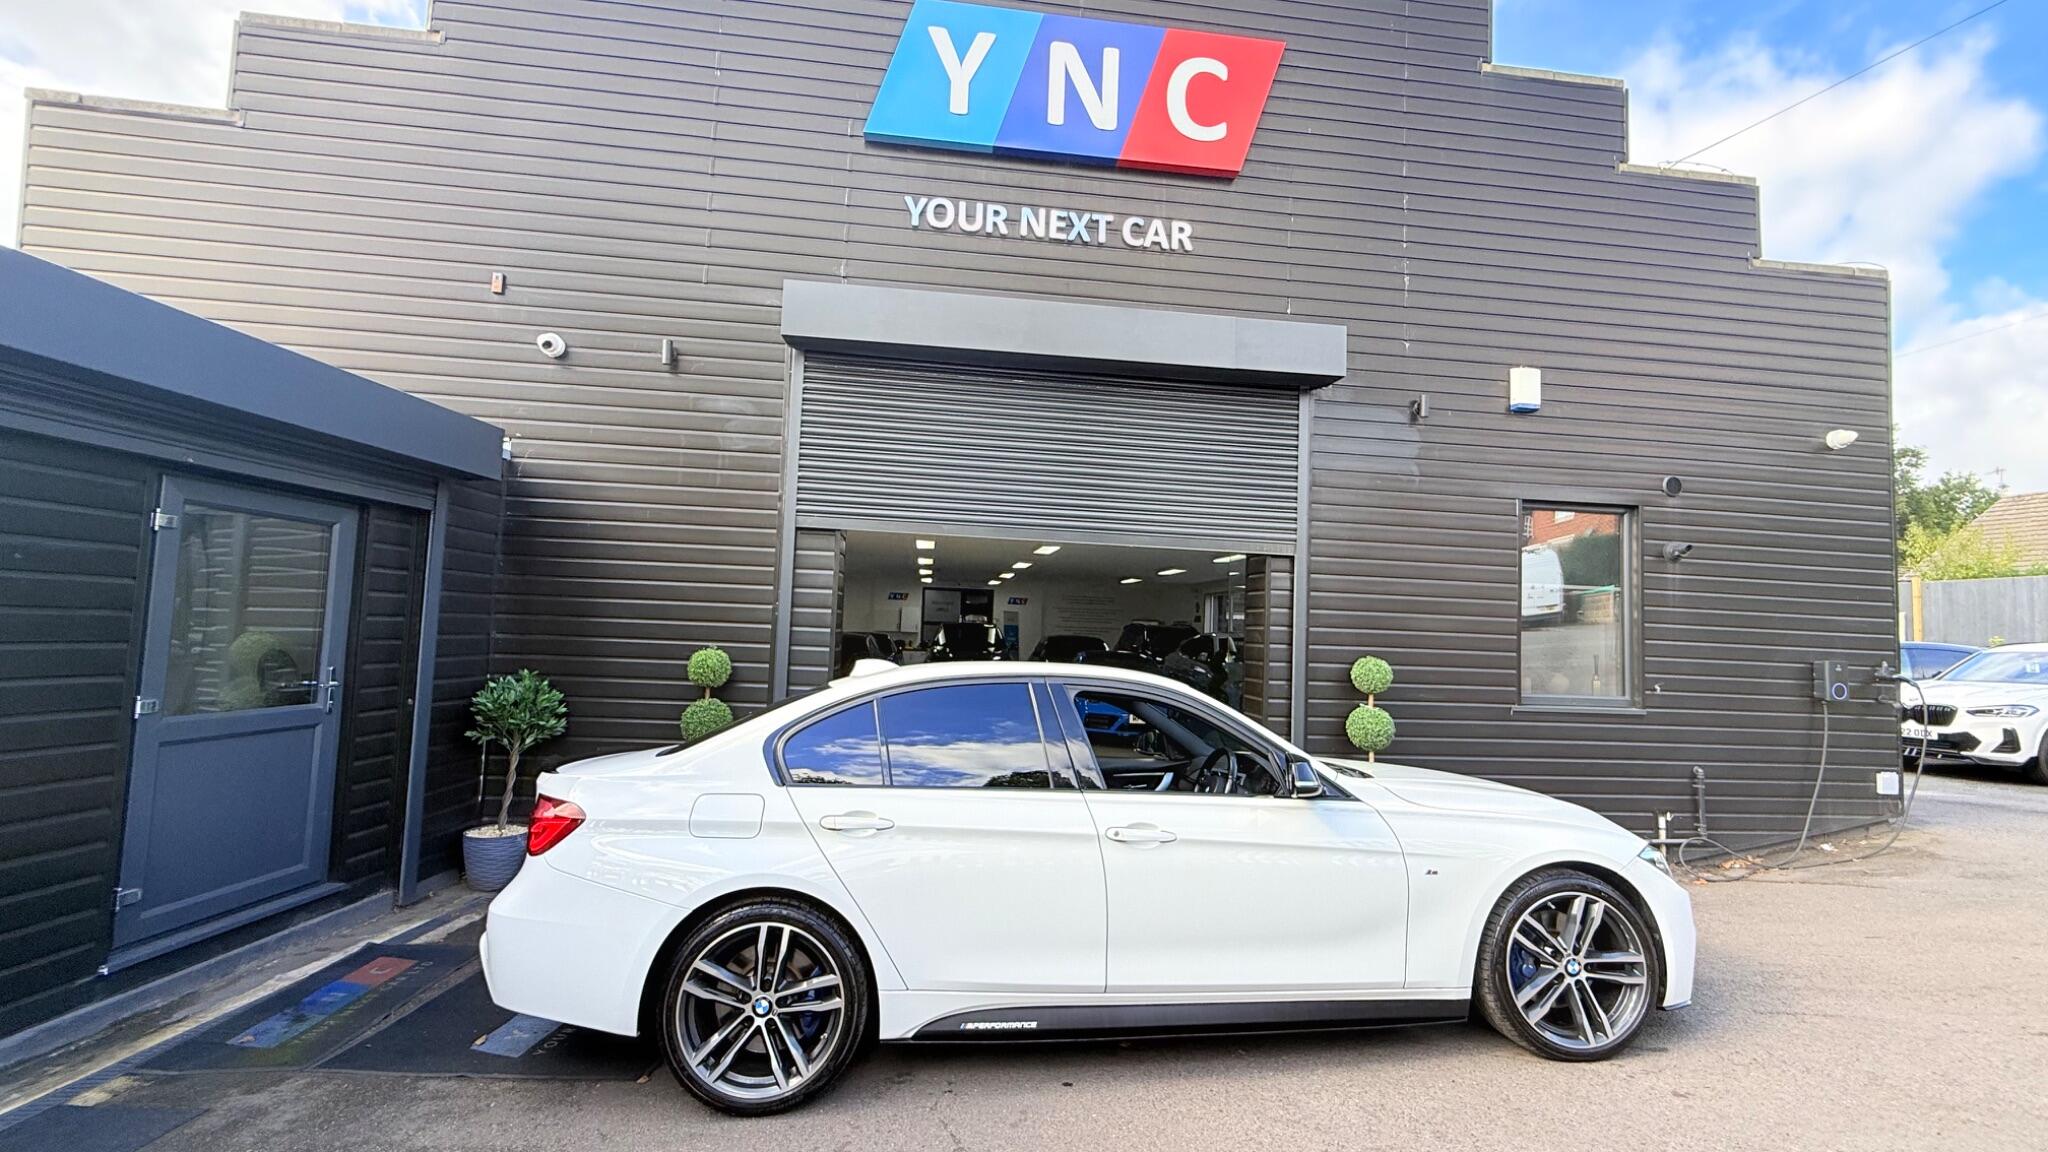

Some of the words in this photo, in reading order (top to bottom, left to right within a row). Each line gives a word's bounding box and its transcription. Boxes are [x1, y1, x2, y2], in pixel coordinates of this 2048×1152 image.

[928, 26, 1229, 142] YNC
[904, 195, 1008, 235] YOUR
[1019, 206, 1112, 244] NEXT
[1121, 215, 1194, 252] CAR
